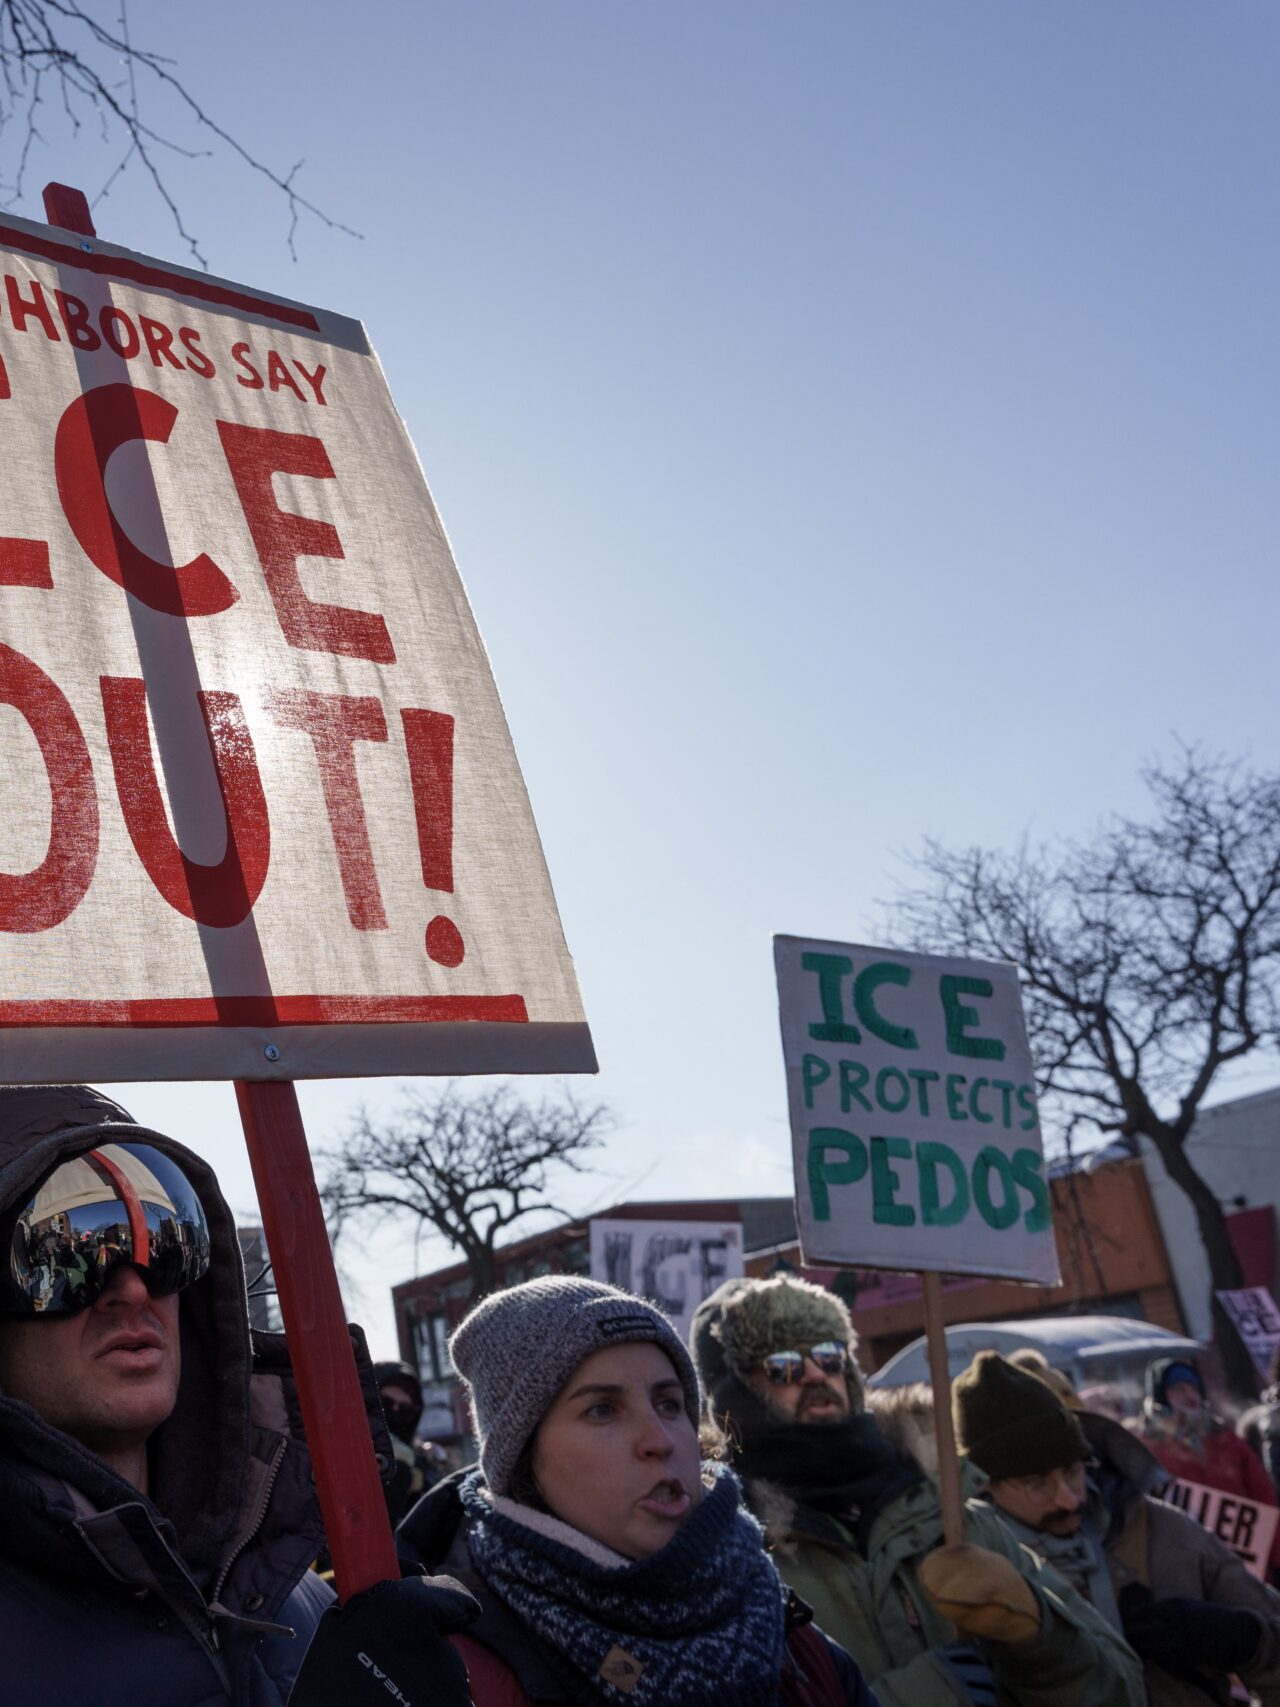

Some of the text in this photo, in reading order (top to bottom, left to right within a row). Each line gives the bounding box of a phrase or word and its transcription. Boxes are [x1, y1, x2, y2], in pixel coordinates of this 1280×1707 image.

[231, 341, 327, 406] SAY
[801, 952, 1007, 1061] ICE
[802, 1053, 1039, 1131] PROTECTS
[806, 1126, 1053, 1234] PEDOS
[357, 1652, 412, 1707] HEAD
